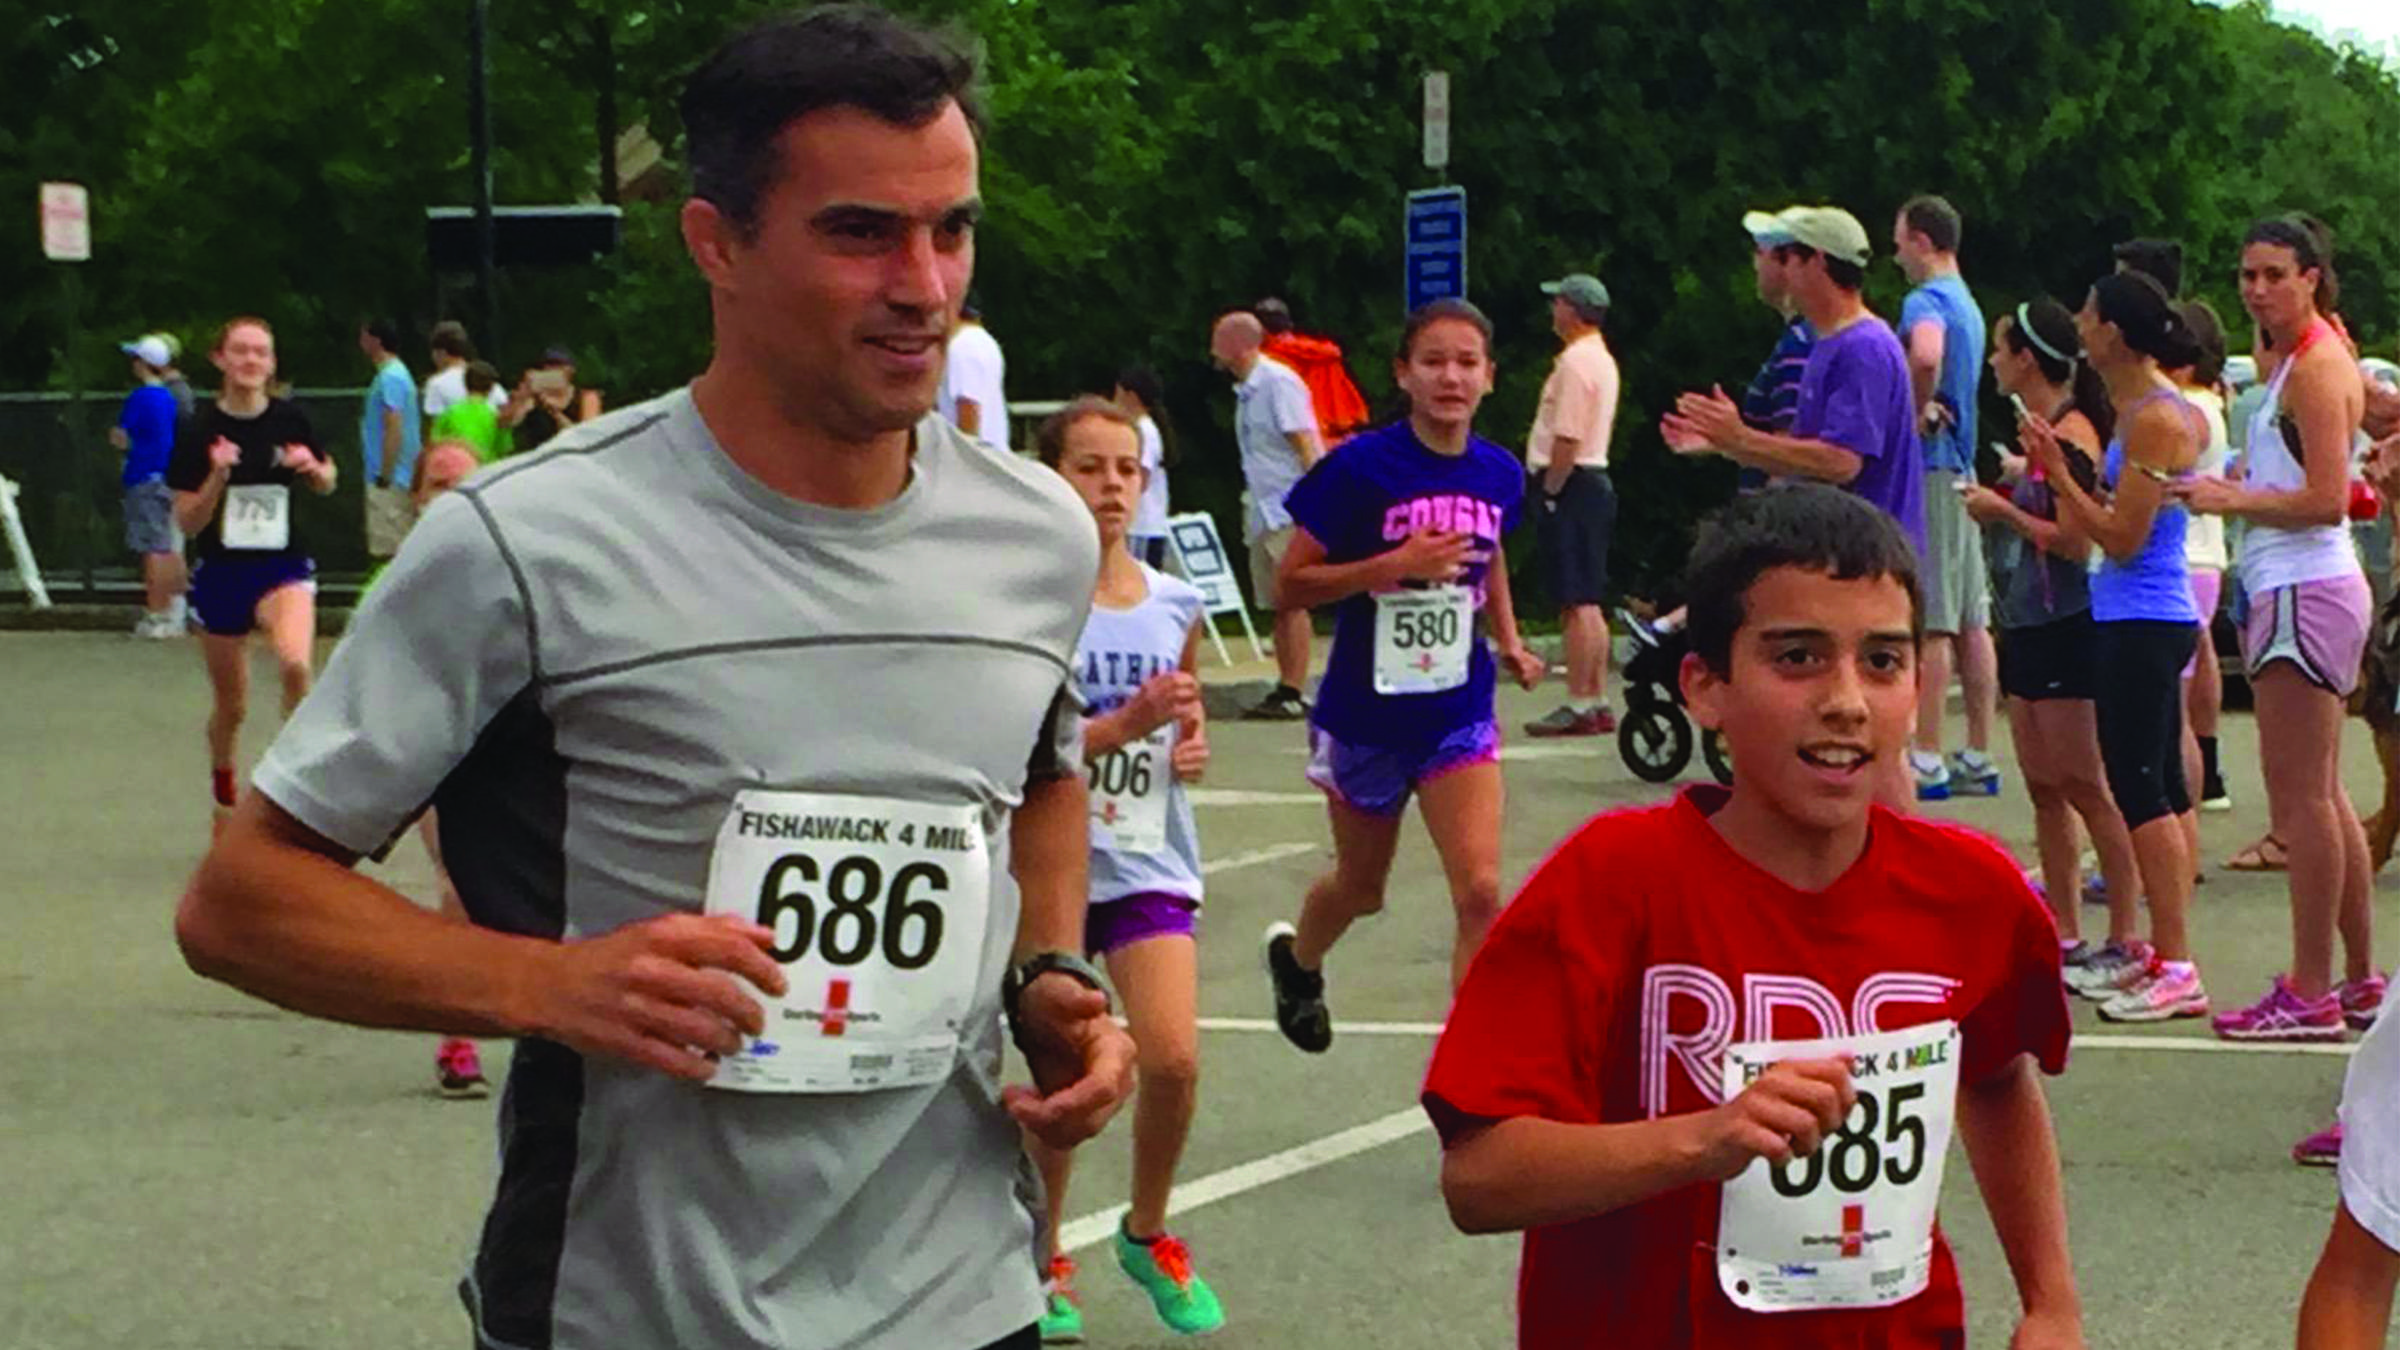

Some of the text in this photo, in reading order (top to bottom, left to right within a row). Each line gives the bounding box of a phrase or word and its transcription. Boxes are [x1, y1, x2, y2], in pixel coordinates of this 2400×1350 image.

[1393, 608, 1458, 649] 580
[738, 811, 890, 843] FISHAWACK
[898, 824, 915, 847] 4
[757, 852, 949, 970] 686
[1886, 1052, 1899, 1072] 4
